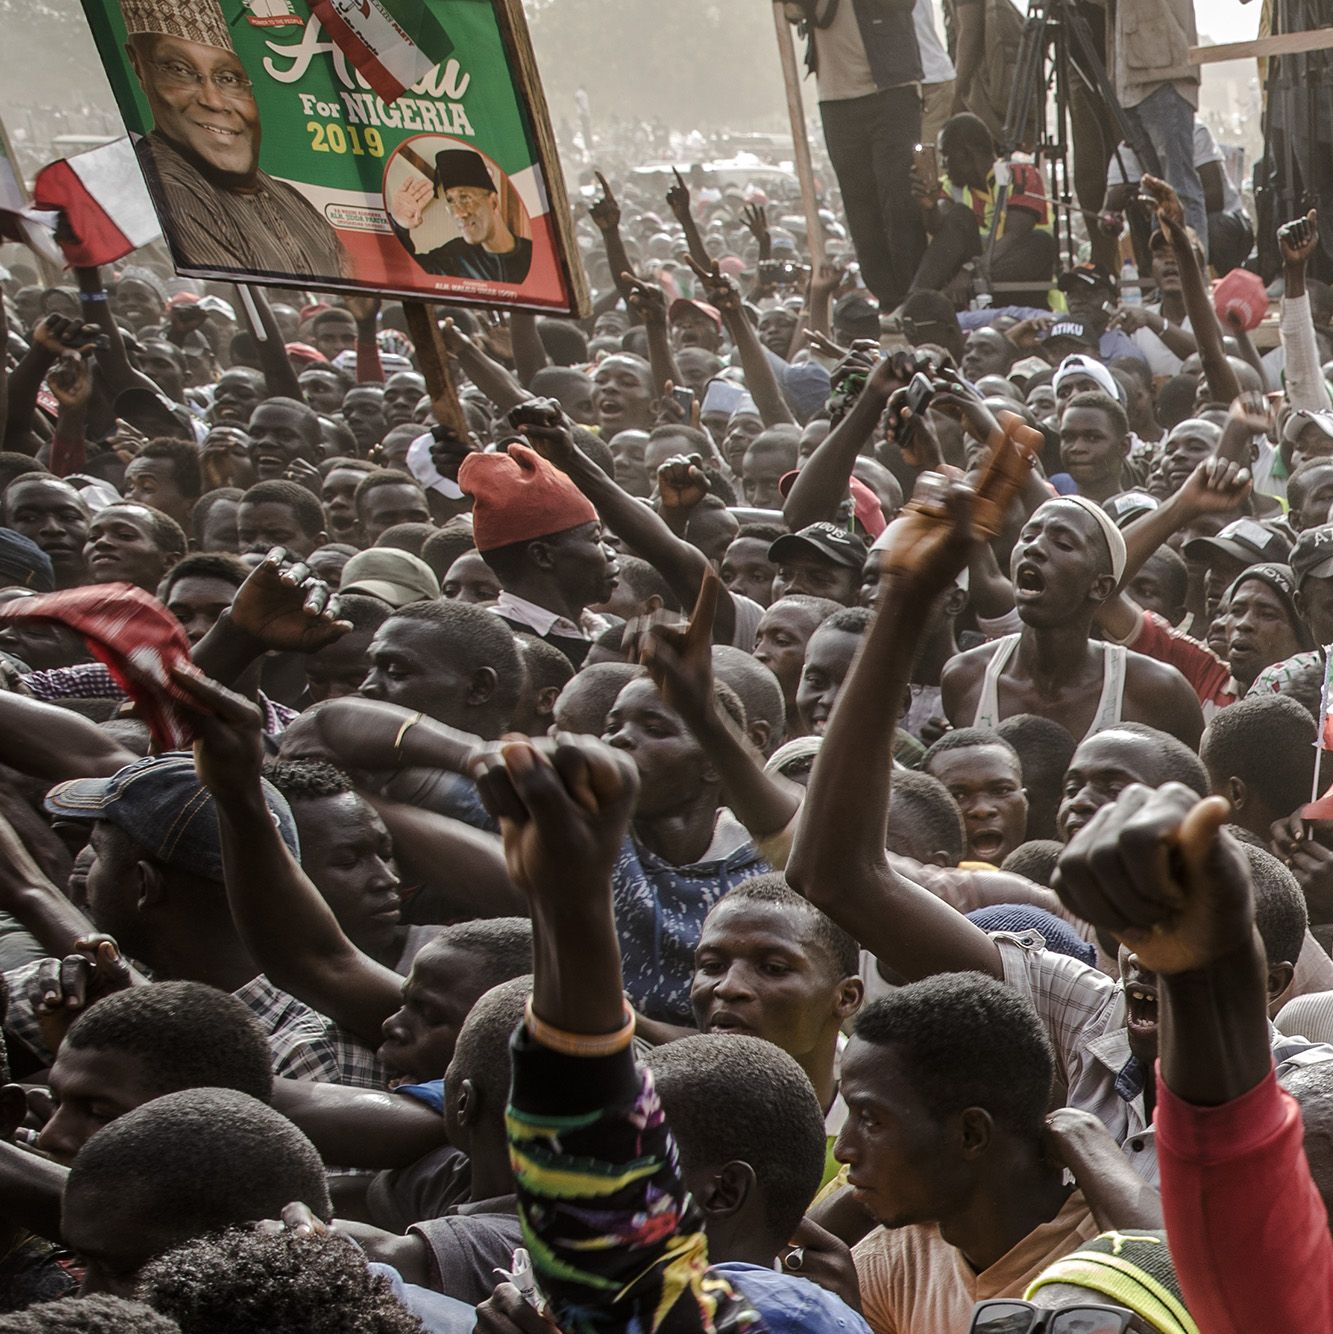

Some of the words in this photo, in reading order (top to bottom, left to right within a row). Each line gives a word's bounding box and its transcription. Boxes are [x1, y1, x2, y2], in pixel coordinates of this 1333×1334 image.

[391, 22, 416, 48] PARTY
[298, 93, 341, 118] For
[340, 91, 476, 137] NIGERIA
[306, 120, 385, 158] 2019
[1050, 322, 1084, 337] ATIKU
